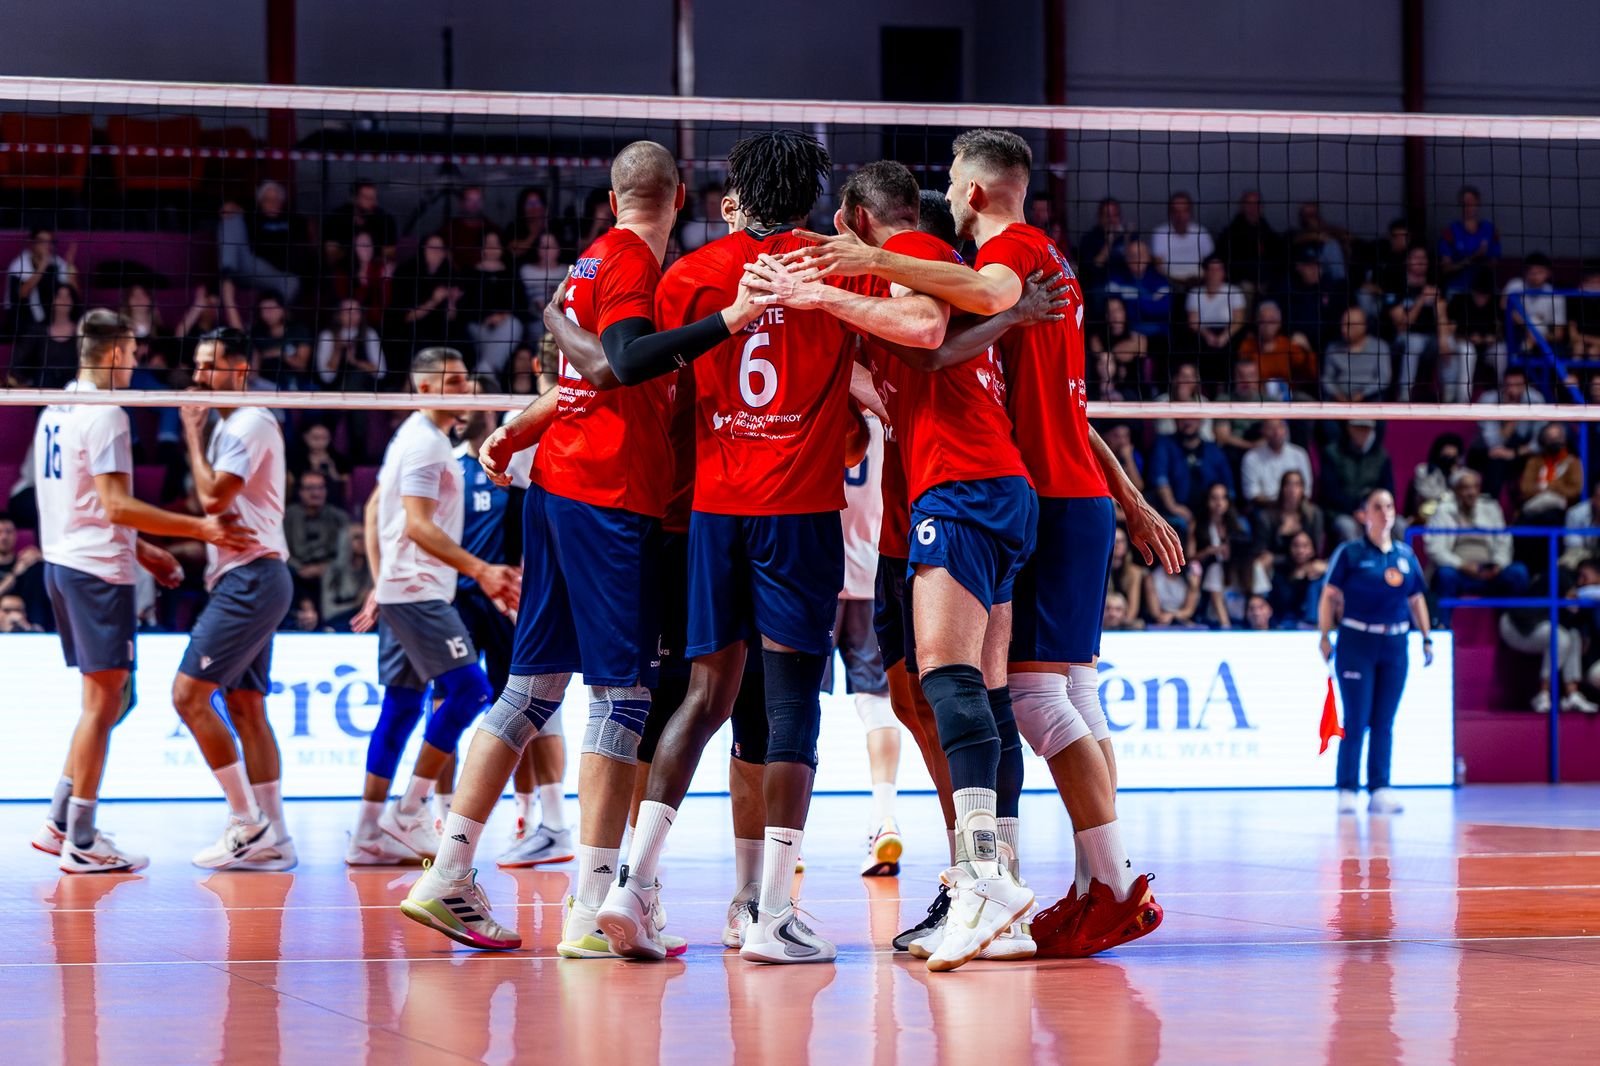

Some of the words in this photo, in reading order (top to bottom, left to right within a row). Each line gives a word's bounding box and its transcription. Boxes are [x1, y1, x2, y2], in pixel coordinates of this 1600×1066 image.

[739, 332, 778, 408] 6
[44, 424, 62, 480] 16
[473, 490, 491, 512] 18
[445, 636, 469, 660] 15
[298, 751, 359, 766] MINE
[1180, 742, 1260, 760] WATER
